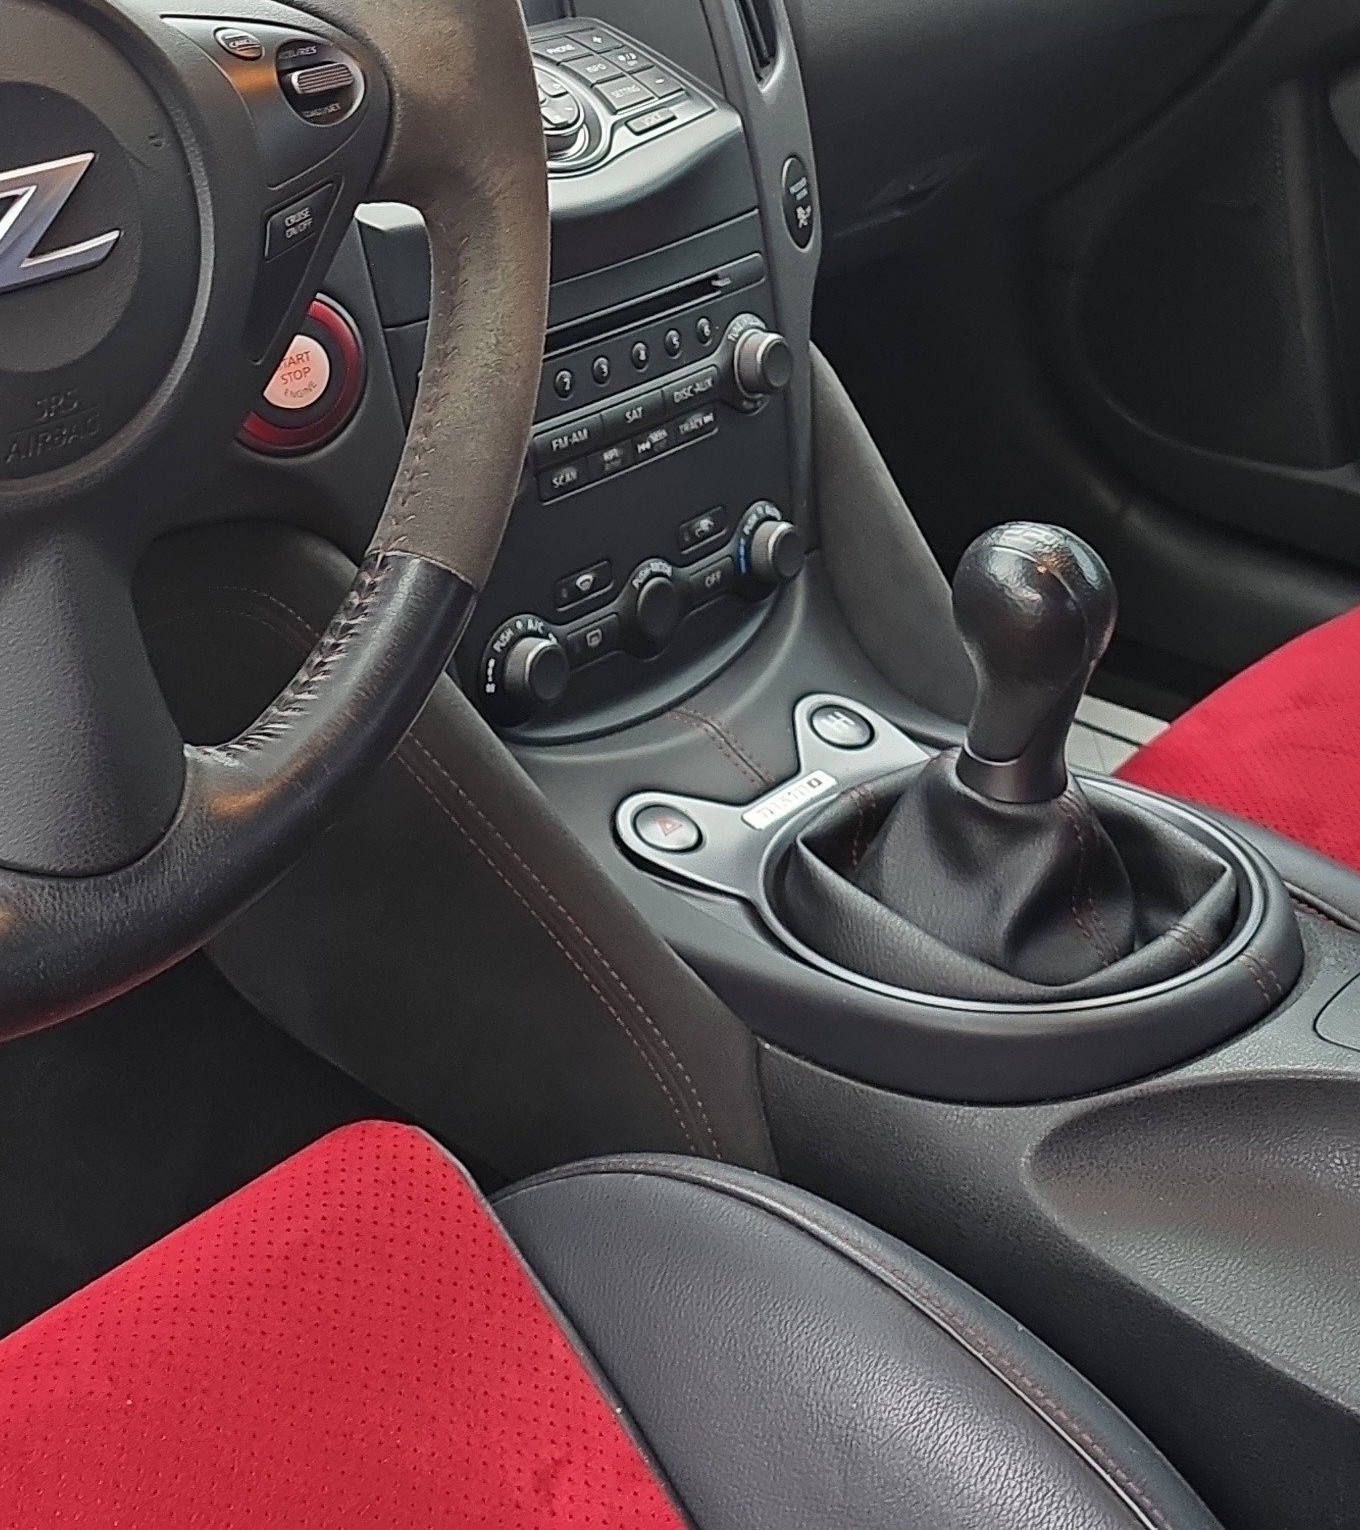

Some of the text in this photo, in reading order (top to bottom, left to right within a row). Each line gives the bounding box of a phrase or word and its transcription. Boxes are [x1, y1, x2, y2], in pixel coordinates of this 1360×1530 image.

[285, 207, 311, 227] CRUISE
[281, 367, 311, 385] STOP
[284, 381, 317, 398] ENGINE
[625, 407, 643, 424] SAT
[552, 470, 578, 488] SCAN
[705, 570, 722, 588] OFF
[493, 628, 515, 653] PUSH
